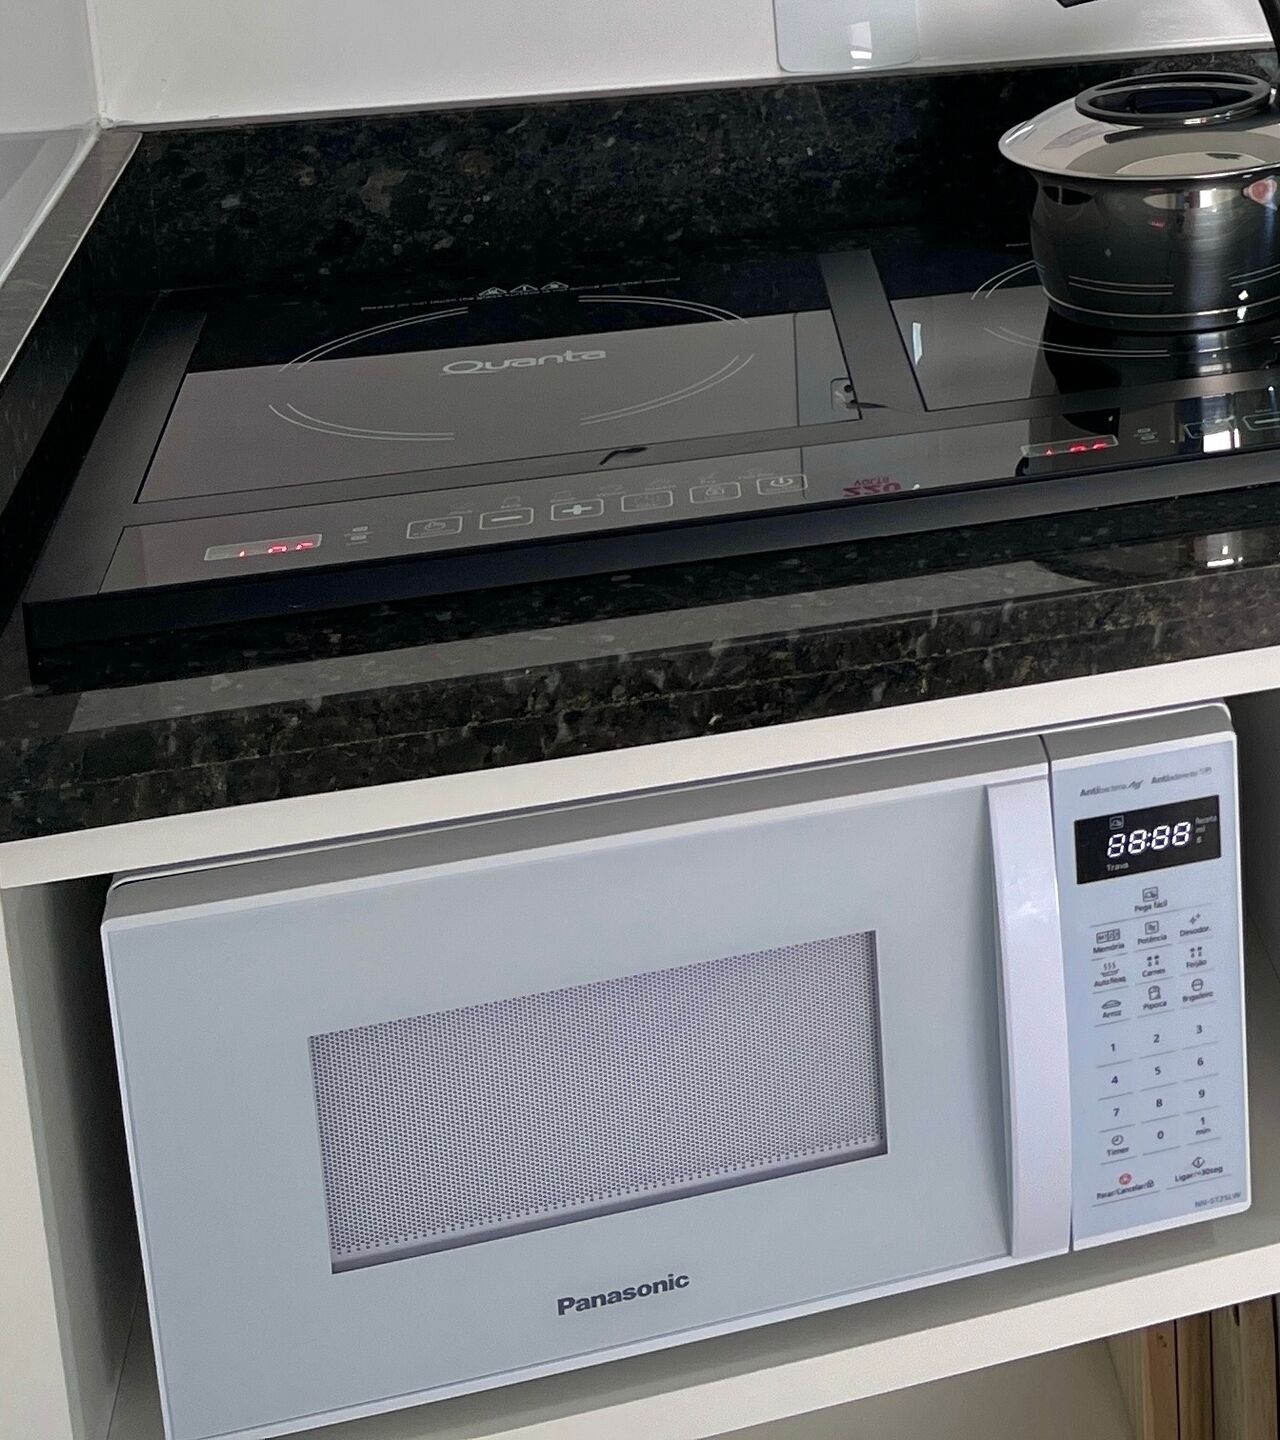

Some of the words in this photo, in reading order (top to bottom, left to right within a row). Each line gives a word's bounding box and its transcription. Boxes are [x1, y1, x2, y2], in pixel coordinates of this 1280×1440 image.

[440, 350, 606, 376] Quanta
[1106, 821, 1191, 859] 88:88
[1134, 904, 1152, 913] Pega
[1153, 900, 1168, 909] fácil
[1137, 934, 1168, 945] Potência
[1092, 942, 1125, 954] Memória
[1143, 1000, 1168, 1011] Pipoca
[1197, 1025, 1203, 1034] 3
[1153, 1034, 1160, 1044] 2
[1110, 1043, 1116, 1052] 1
[1197, 1057, 1204, 1066] 6
[1155, 1066, 1161, 1076] 5
[1111, 1075, 1119, 1084] 4
[1198, 1089, 1205, 1098] 9
[1156, 1098, 1163, 1108] 8
[1113, 1108, 1120, 1117] 7
[1200, 1117, 1205, 1125] 1
[1157, 1130, 1164, 1140] 0
[1195, 1126, 1211, 1136] min
[1107, 1146, 1130, 1157] Timer
[557, 1273, 690, 1316] Panasonic
